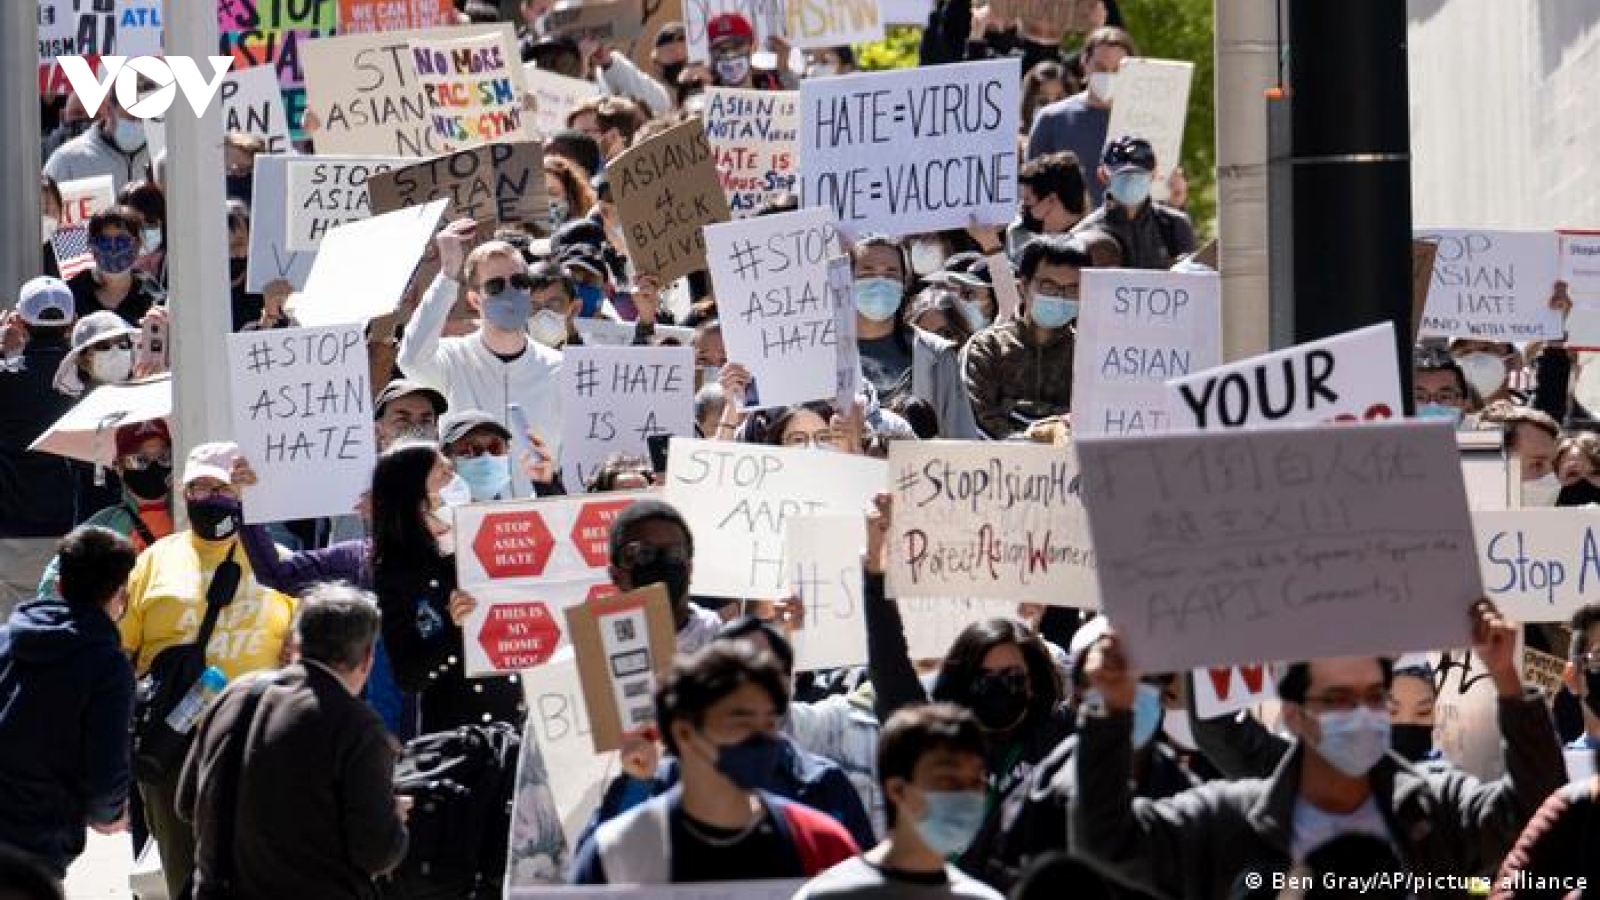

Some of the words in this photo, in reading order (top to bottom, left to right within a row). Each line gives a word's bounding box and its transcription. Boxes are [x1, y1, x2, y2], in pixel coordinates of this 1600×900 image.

[354, 45, 410, 92] ST
[413, 47, 448, 75] NO
[451, 45, 504, 74] MORE
[326, 92, 425, 131] ASIAN
[423, 78, 515, 110] RACISM
[814, 80, 1002, 149] HATE=VIRUS
[393, 143, 513, 194] STOP
[619, 132, 710, 198] ASIANS
[771, 153, 791, 171] IS
[303, 189, 370, 211] ASIA
[631, 194, 710, 251] BLACK
[729, 220, 841, 281] #STOP
[1113, 286, 1191, 320] STOP
[246, 330, 361, 374] #STOP
[760, 318, 838, 359] HATE
[611, 363, 684, 394] HATE
[1101, 346, 1191, 377] ASIAN
[248, 374, 365, 421] ASIAN
[1177, 348, 1340, 429] YOUR
[585, 409, 617, 441] IS
[632, 409, 668, 441] A
[1103, 408, 1171, 438] HAT
[264, 424, 362, 463] HATE
[675, 449, 784, 490] STOP
[895, 456, 1082, 513] #StopAsianHa
[493, 537, 537, 550] ASIAN
[495, 521, 532, 534] STOP
[495, 551, 536, 566] HATE
[1486, 530, 1565, 604] Stop
[494, 607, 527, 621] THIS
[528, 606, 544, 619] IS
[507, 622, 529, 635] MY
[497, 637, 541, 652] HOME
